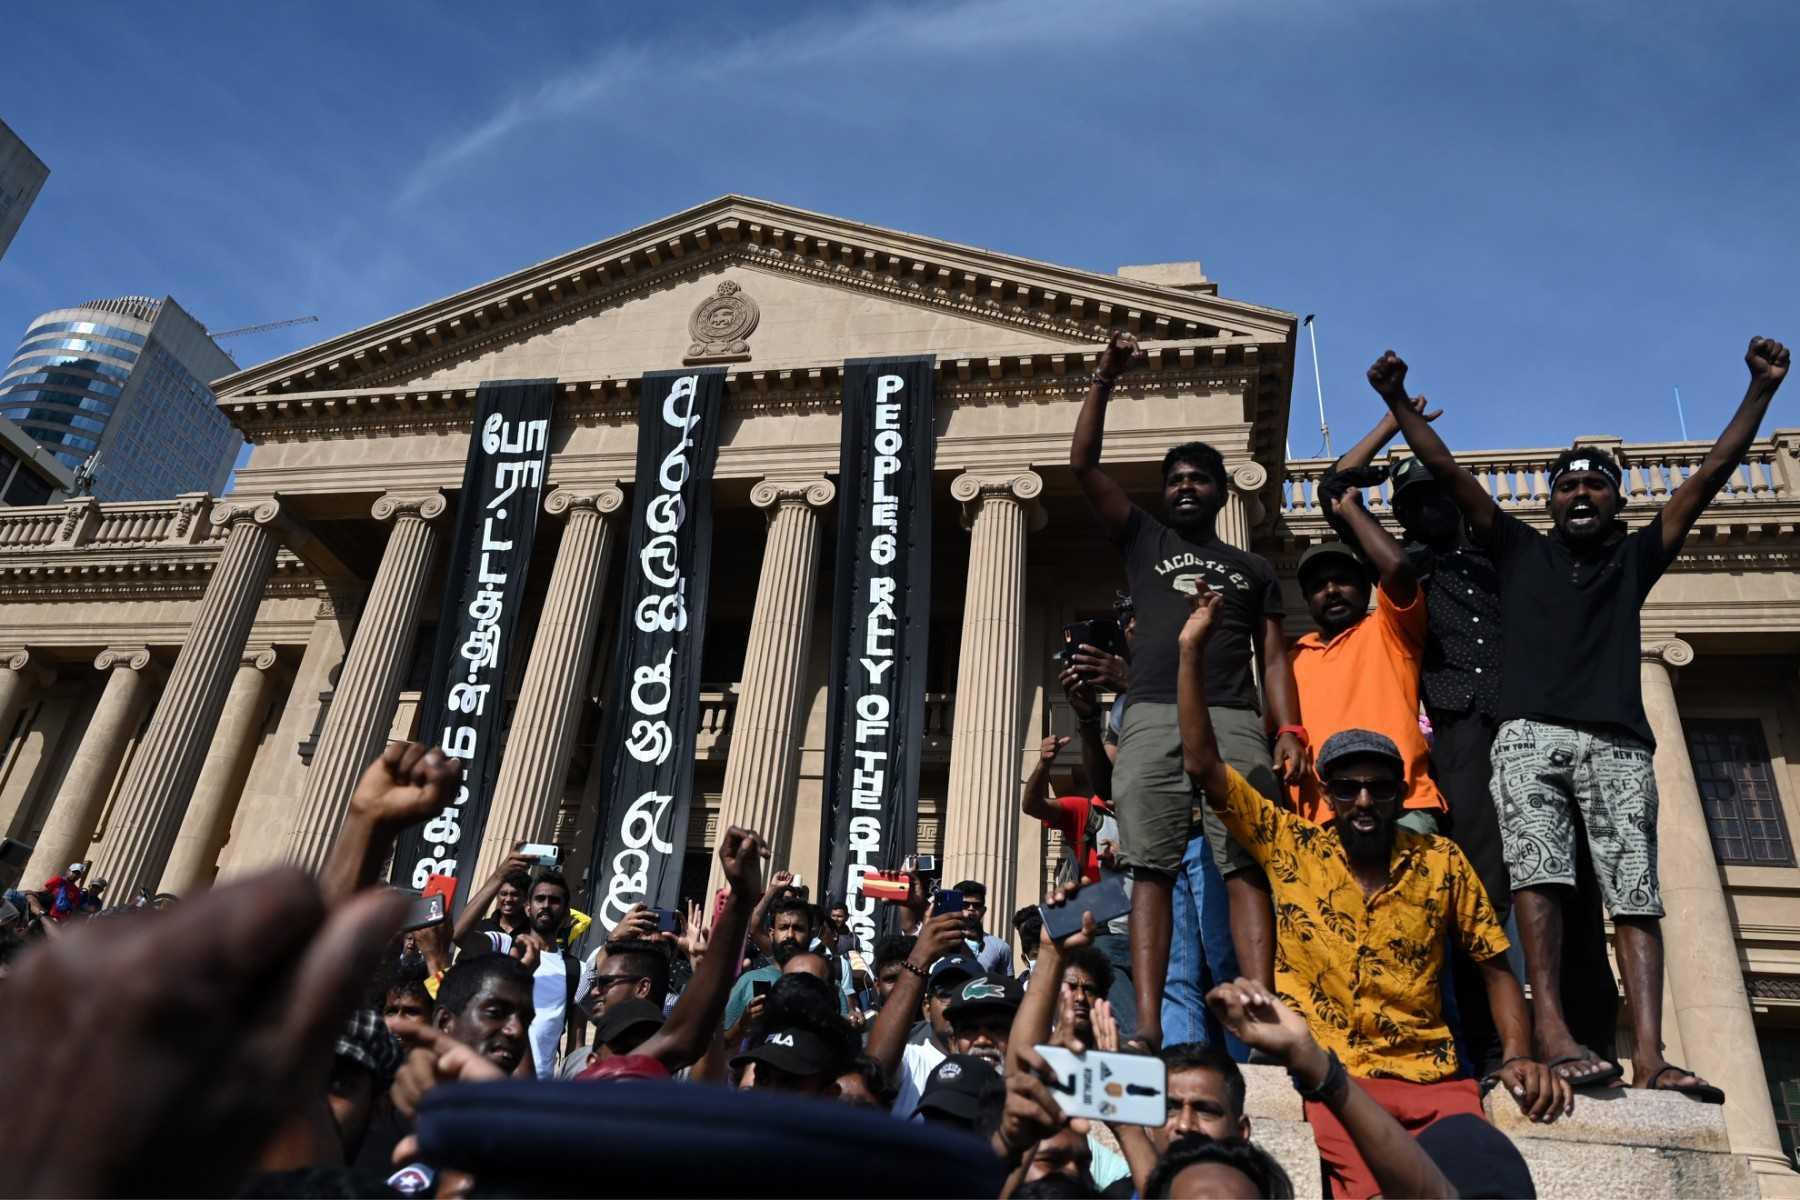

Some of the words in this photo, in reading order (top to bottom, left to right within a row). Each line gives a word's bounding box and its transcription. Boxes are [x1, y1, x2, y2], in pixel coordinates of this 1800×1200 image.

[870, 374, 904, 566] PEOPLE'S
[1154, 553, 1226, 575] LACOSTE
[860, 577, 897, 684] RALLY
[855, 694, 890, 744] OF
[1613, 749, 1632, 760] NEW
[851, 750, 887, 811] THE
[764, 1033, 794, 1047] FILA
